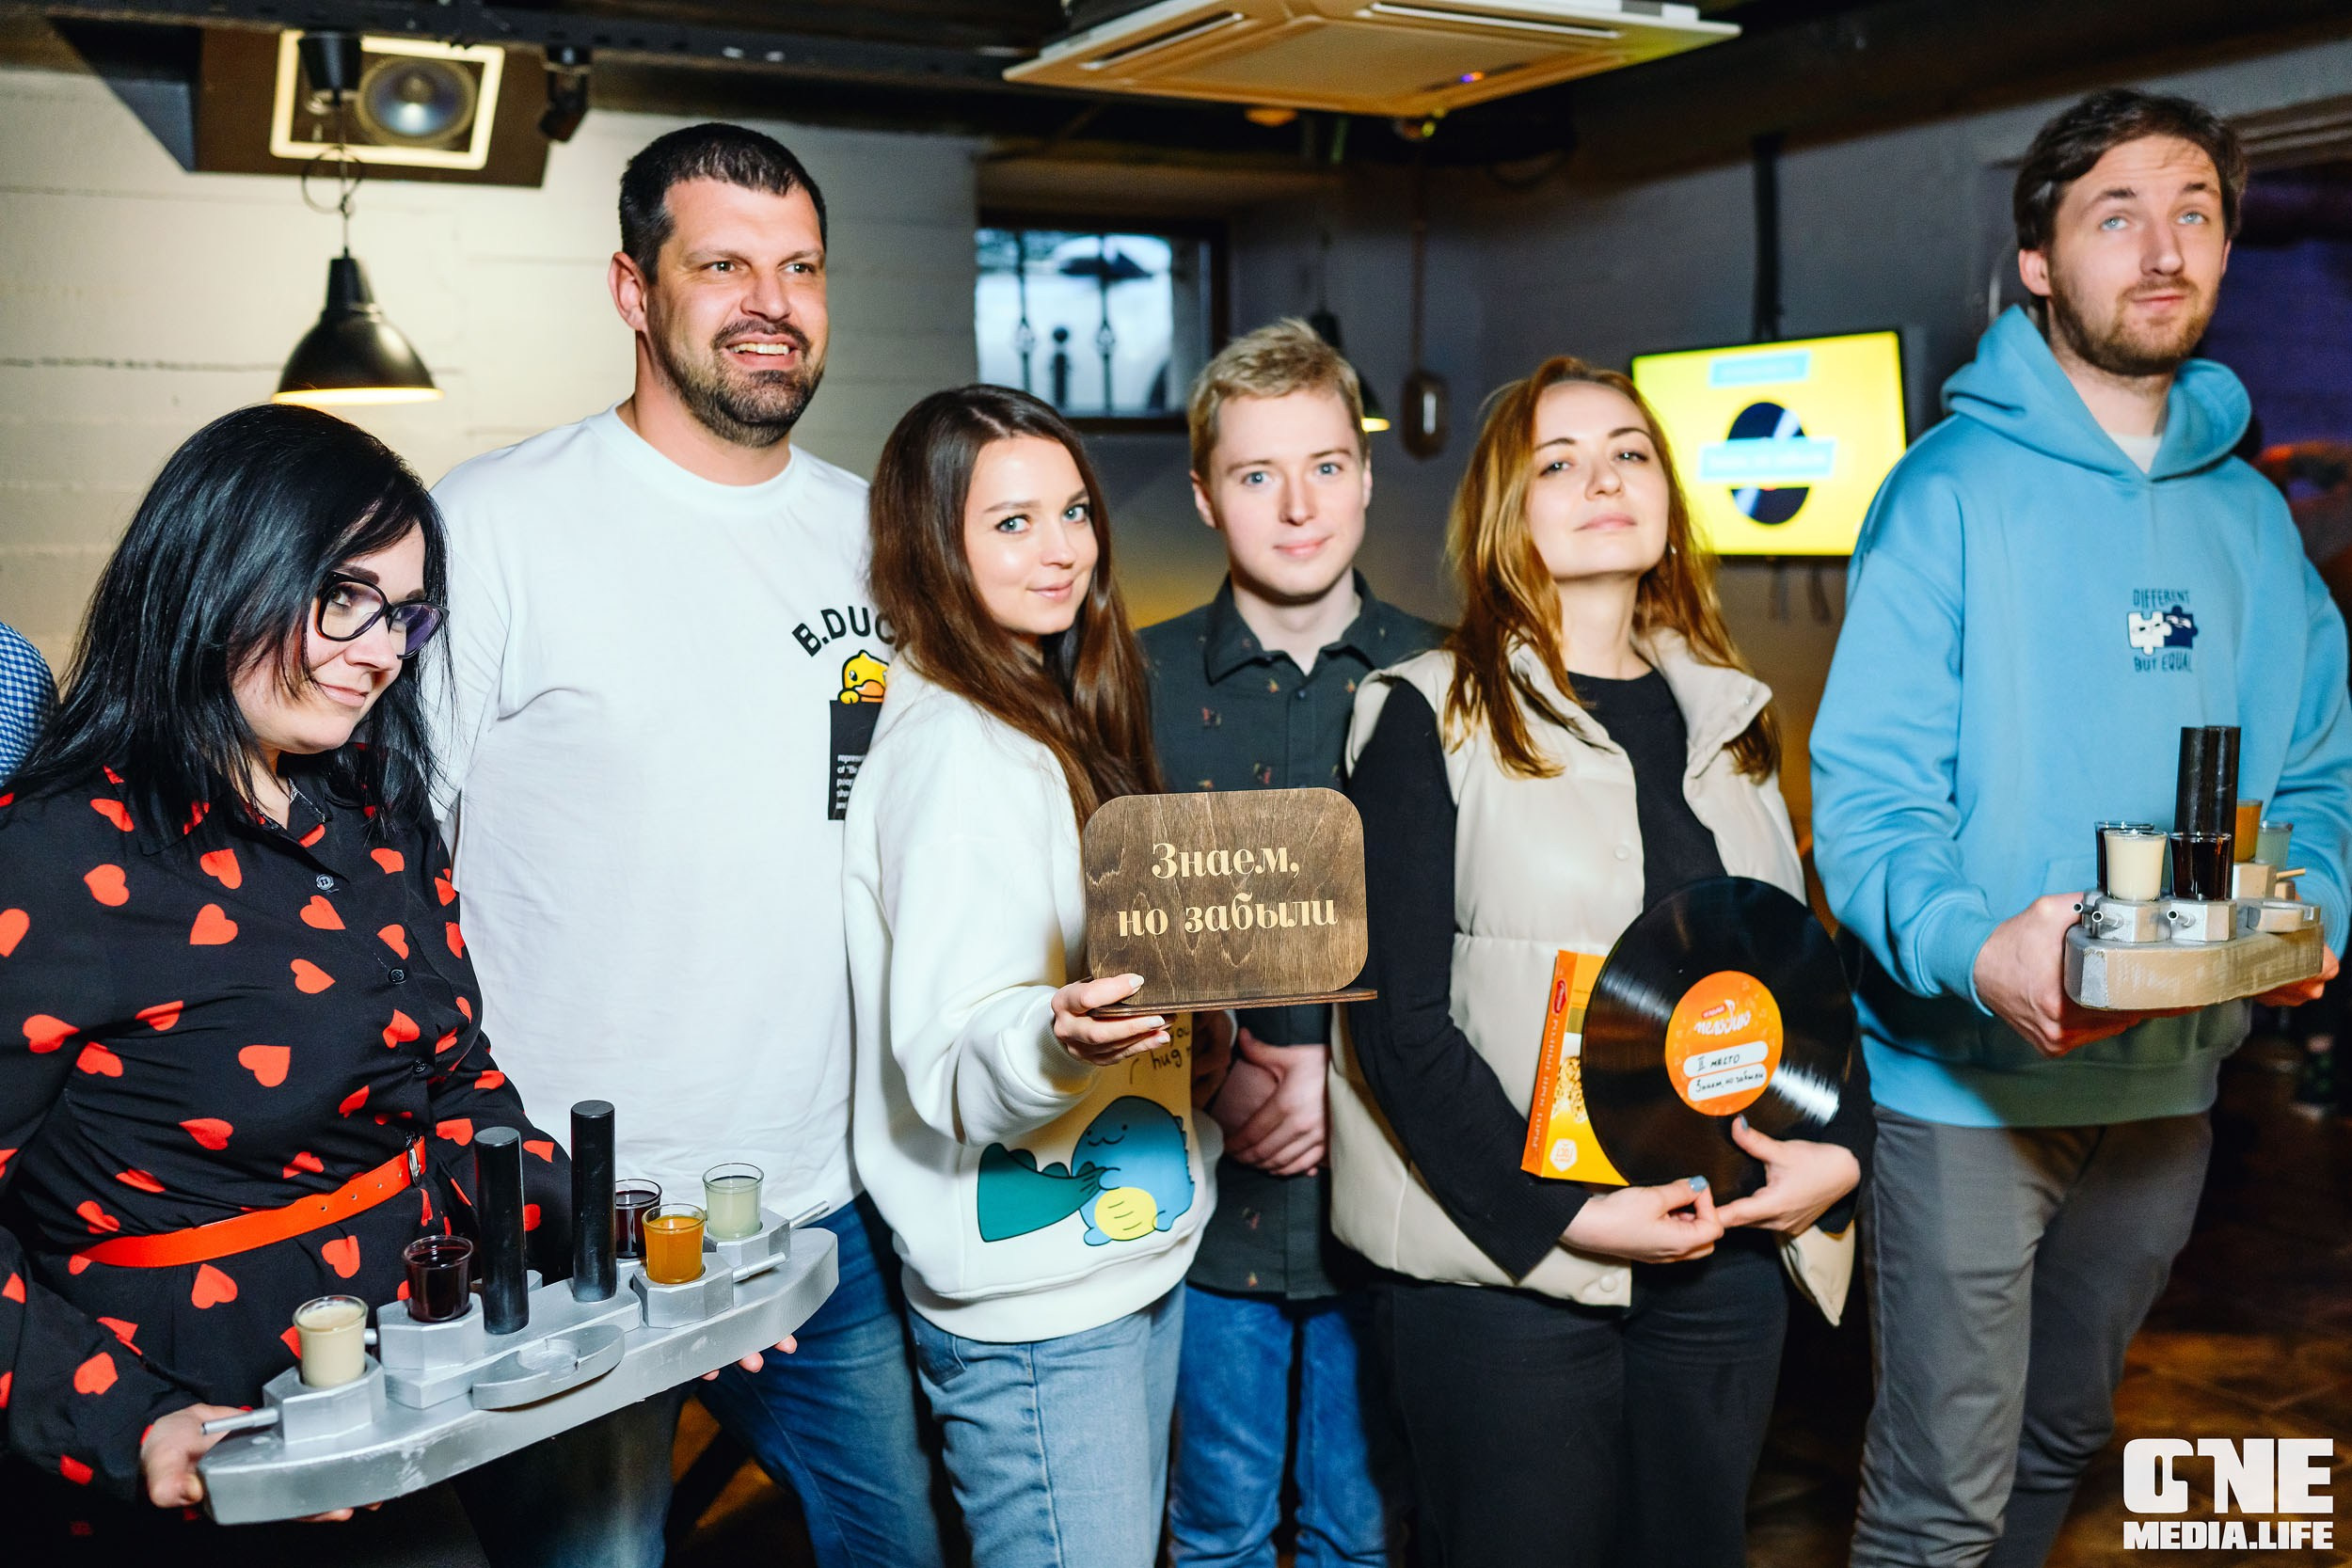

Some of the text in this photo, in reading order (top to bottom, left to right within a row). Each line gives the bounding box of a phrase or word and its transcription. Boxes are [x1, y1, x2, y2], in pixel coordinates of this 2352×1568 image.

[2133, 589, 2190, 610] DIFFERENT
[2134, 652, 2193, 673] BUT EQUAL
[1152, 843, 1300, 879] Знаем,
[1117, 892, 1339, 937] но забыли
[1150, 1048, 1183, 1069] hug
